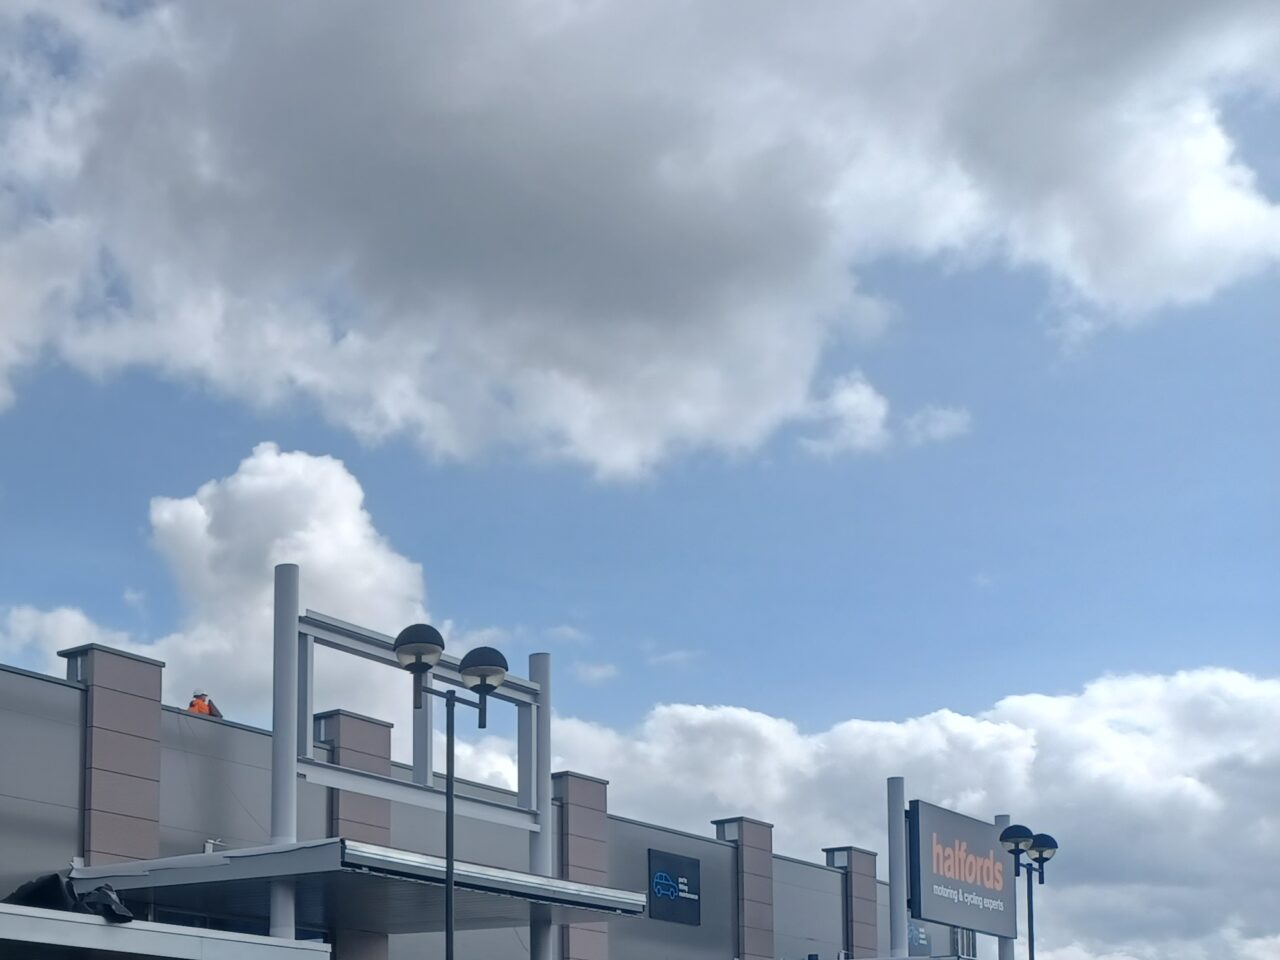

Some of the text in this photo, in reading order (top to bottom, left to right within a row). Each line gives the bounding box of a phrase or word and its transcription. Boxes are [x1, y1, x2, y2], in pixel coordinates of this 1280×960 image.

[932, 831, 1004, 891] halfords
[932, 884, 1004, 912] motoring & cycling experts
